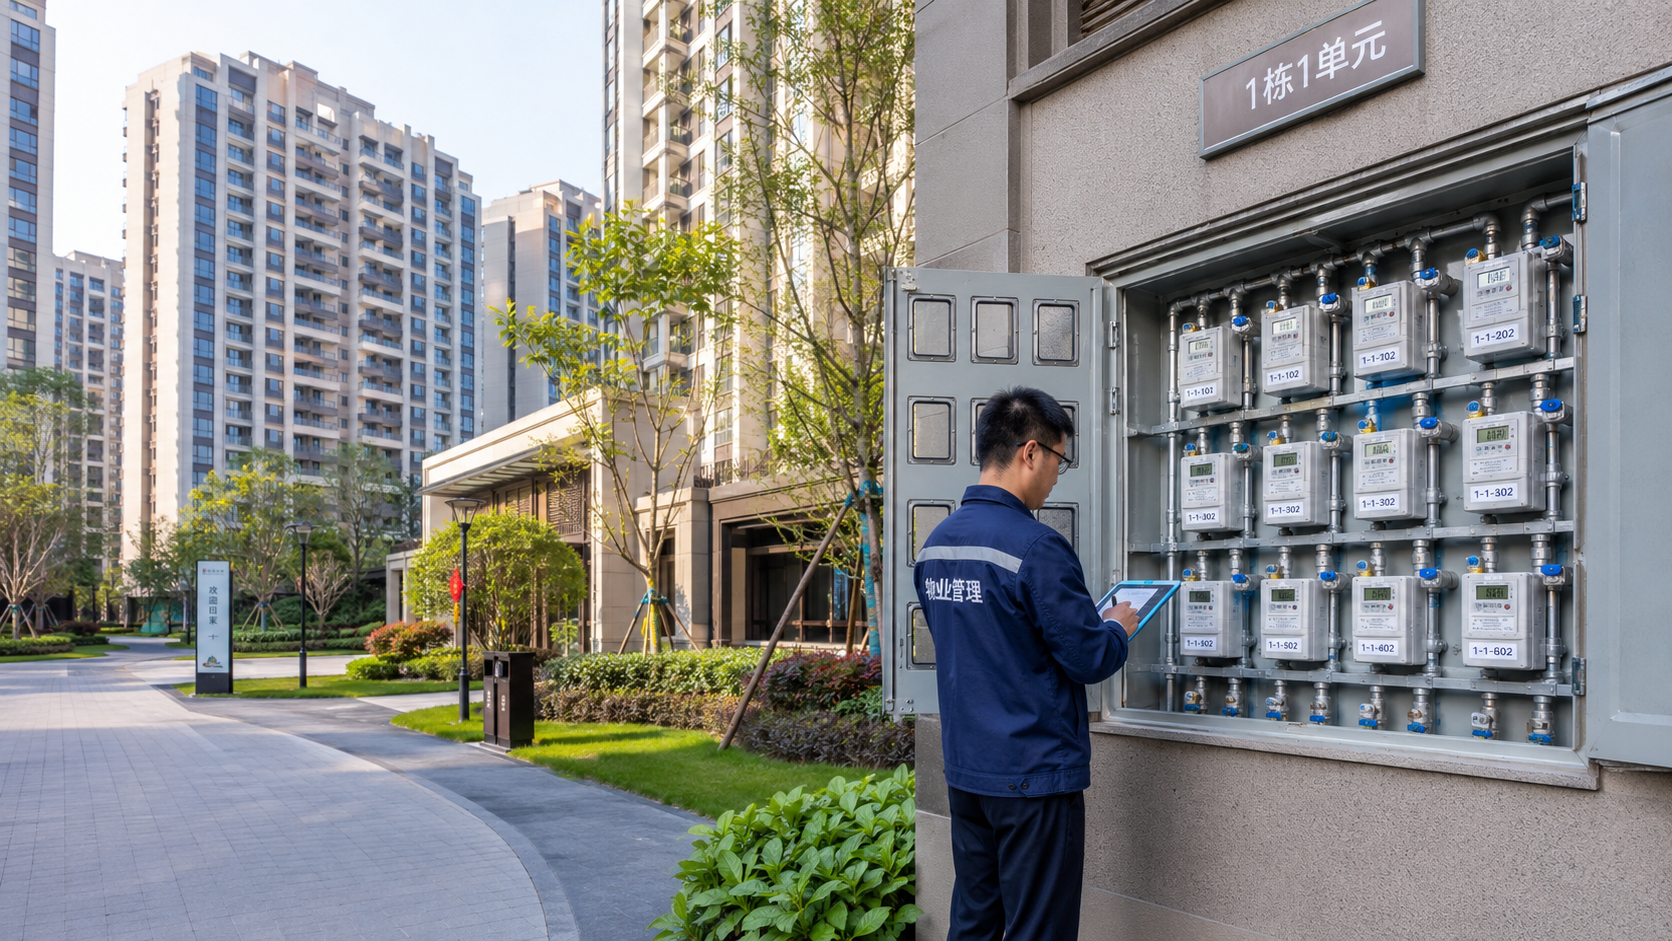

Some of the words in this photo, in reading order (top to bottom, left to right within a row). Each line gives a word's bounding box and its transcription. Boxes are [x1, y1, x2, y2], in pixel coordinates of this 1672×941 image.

[1246, 20, 1386, 110] 1栋1单元
[1475, 328, 1515, 344] 1-1-202
[1361, 350, 1396, 365] 1-1-102
[1269, 369, 1300, 383] 1-1-102
[1474, 487, 1514, 499] 1-1-302
[1361, 497, 1396, 509] 1-1-302
[1270, 505, 1301, 515] 1-1-302
[1361, 643, 1395, 653] 1-1-602
[1473, 646, 1513, 657] 1-1-602
